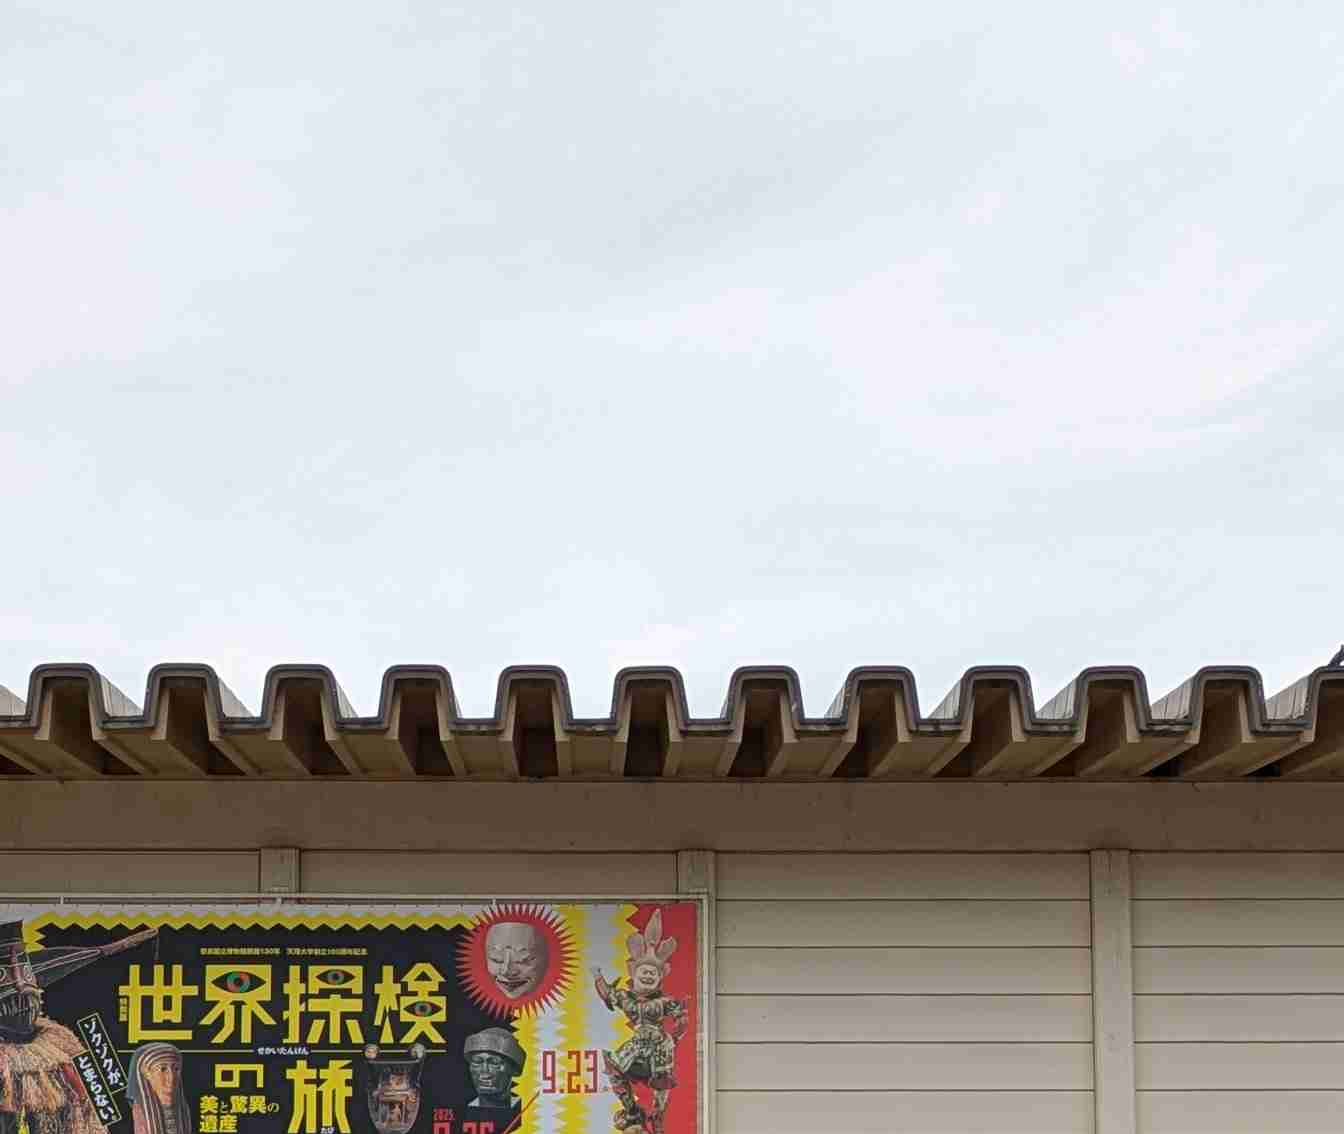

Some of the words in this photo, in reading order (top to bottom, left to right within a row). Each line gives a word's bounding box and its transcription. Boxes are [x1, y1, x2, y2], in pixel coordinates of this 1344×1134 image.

[118, 963, 447, 1044] 世界探検
[543, 1050, 598, 1094] 9.23
[199, 1095, 280, 1114] 美と驚異の
[199, 1115, 238, 1133] 遺産
